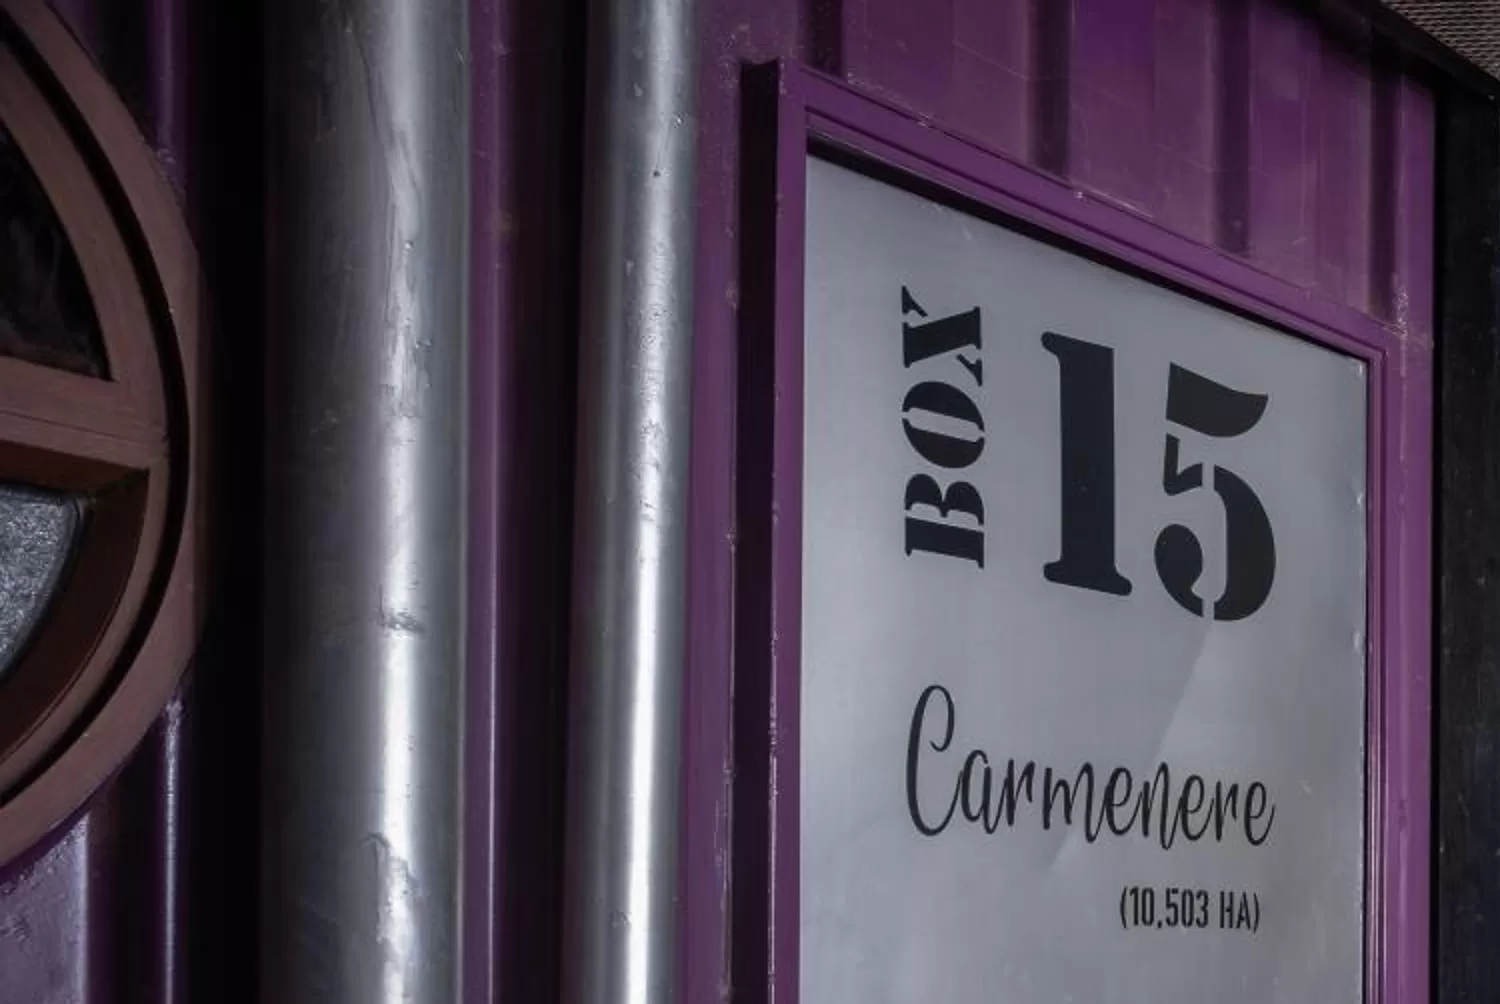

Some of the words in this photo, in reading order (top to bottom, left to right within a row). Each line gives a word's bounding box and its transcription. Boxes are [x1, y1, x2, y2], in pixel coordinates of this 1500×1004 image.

[901, 285, 985, 569] BOX
[1041, 331, 1276, 621] 15
[905, 684, 1276, 851] Carmenere
[1218, 890, 1261, 933] HA)
